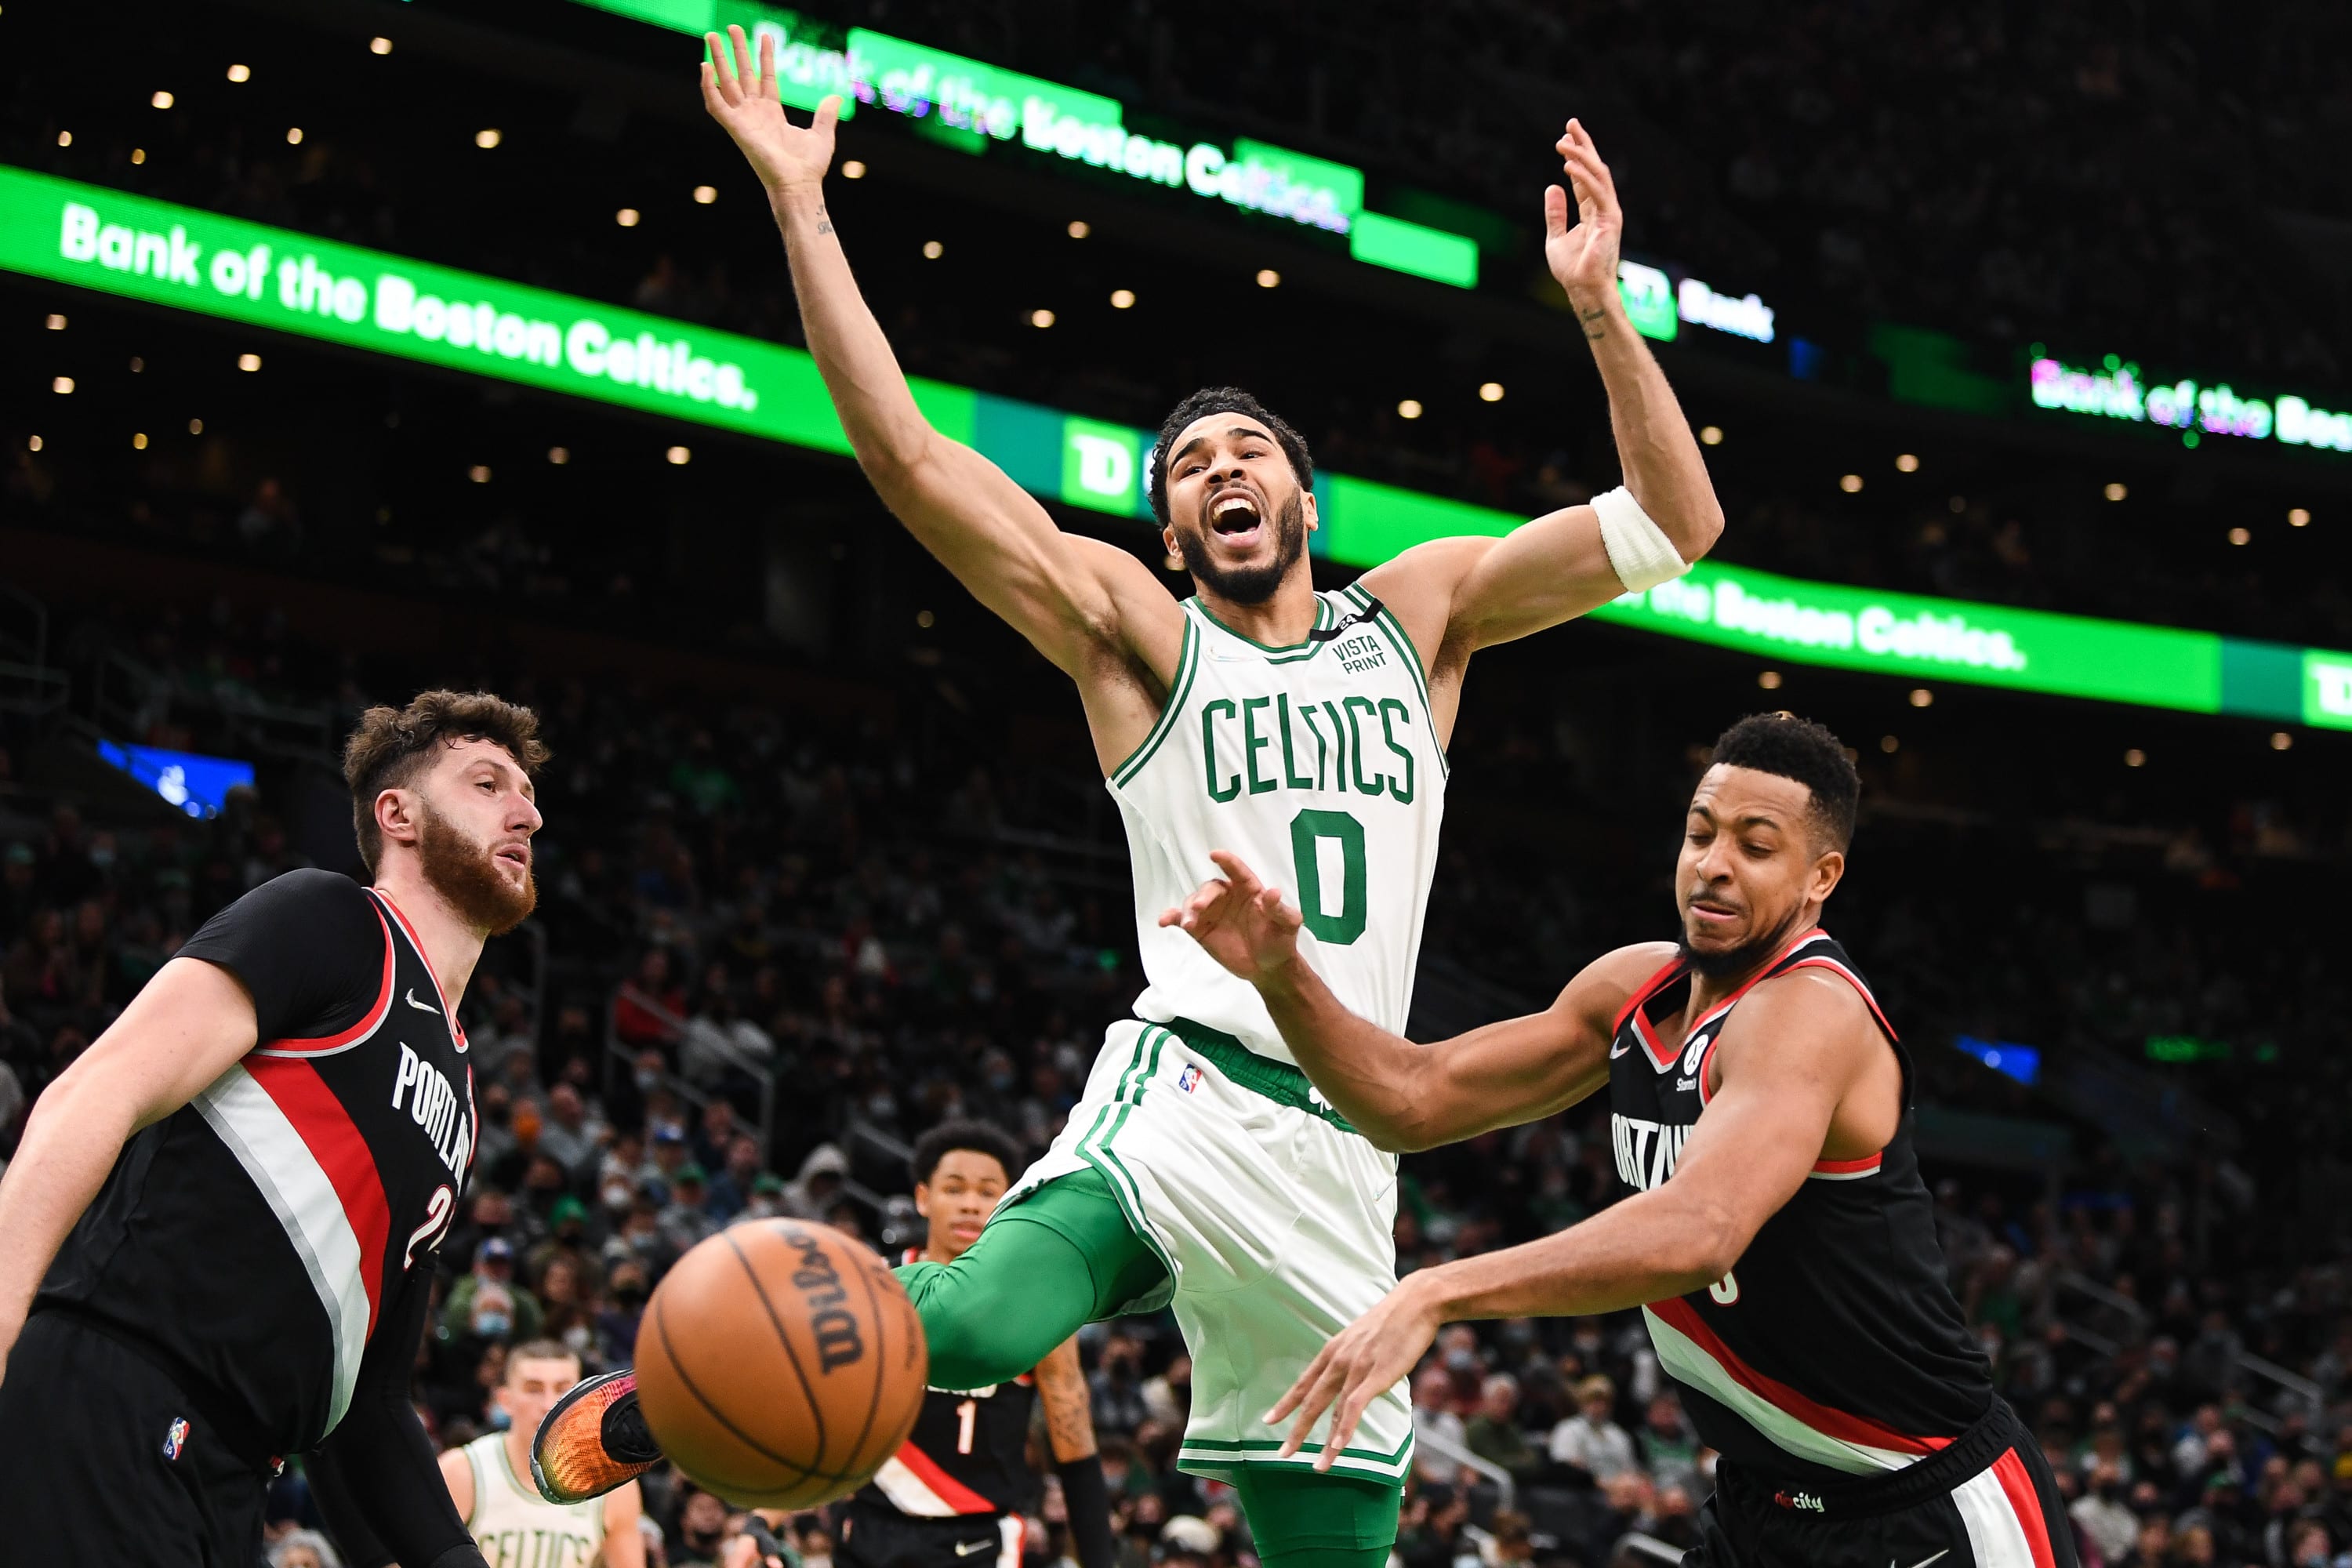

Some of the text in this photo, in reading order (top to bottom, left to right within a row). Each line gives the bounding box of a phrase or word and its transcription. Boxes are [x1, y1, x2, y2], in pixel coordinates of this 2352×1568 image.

[1022, 95, 1184, 187] Boston
[60, 201, 758, 412] Bank of the Boston Celtics.
[1679, 278, 1775, 343] Bank
[1072, 434, 1133, 495] TD
[1338, 615, 1358, 630] 24
[1714, 579, 1854, 650] Boston
[1332, 635, 1381, 662] VISTA
[1342, 652, 1386, 674] PRINT
[1202, 692, 1414, 805] CELTICS
[1290, 808, 1367, 945] 0
[956, 1399, 977, 1455] 1
